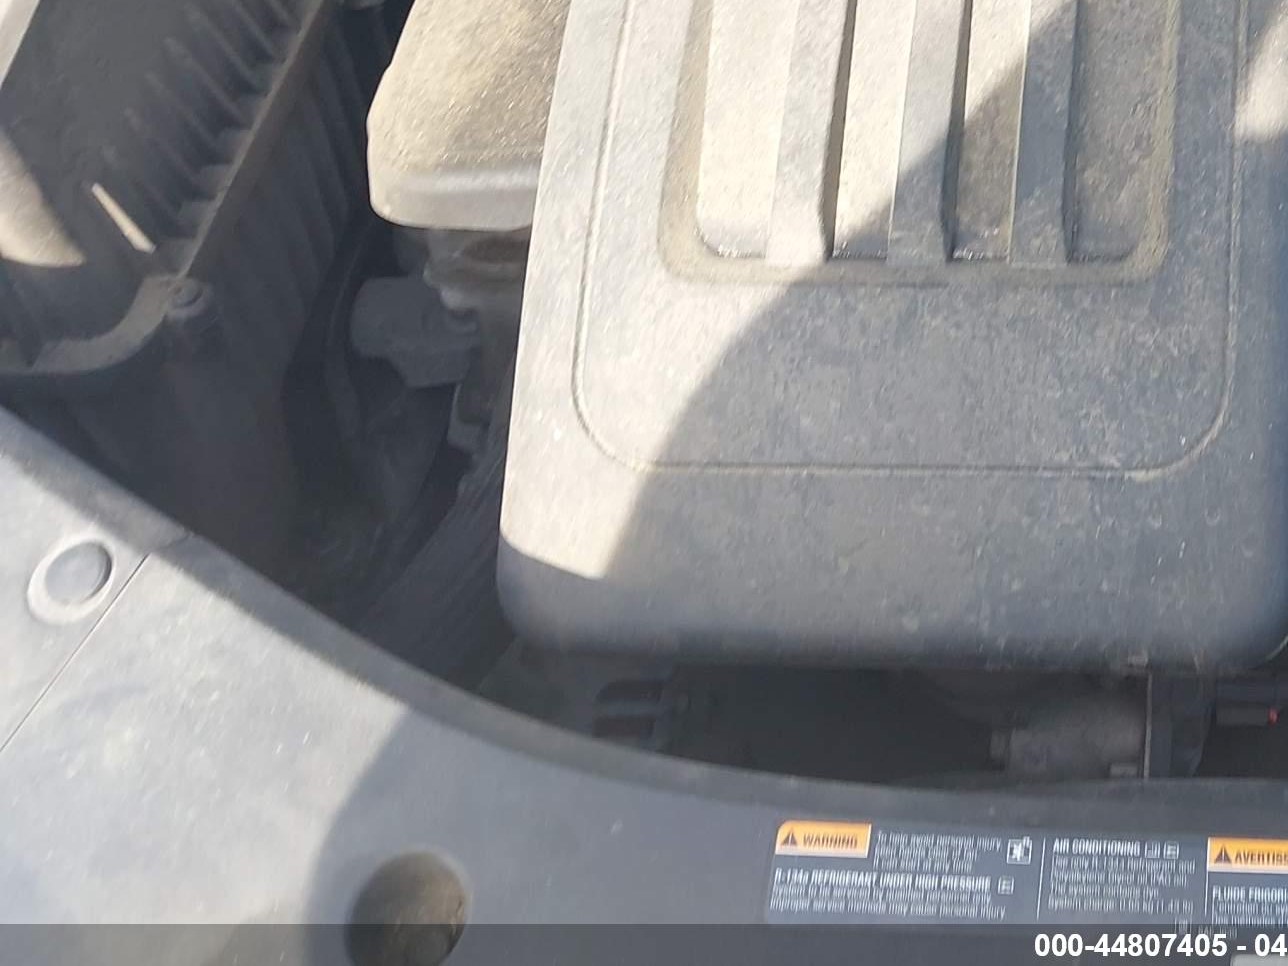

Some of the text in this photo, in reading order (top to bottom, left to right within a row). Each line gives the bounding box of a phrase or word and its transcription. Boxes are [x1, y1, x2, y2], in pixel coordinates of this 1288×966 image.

[803, 832, 858, 849] WARNING
[1053, 838, 1141, 857] AIR CONDITIONING
[811, 869, 878, 887] REFRIGERANT
[880, 872, 912, 889] UNDER
[915, 874, 938, 890] HIGH
[941, 875, 991, 891] PRESSURE
[1212, 885, 1246, 902] FLUIDE
